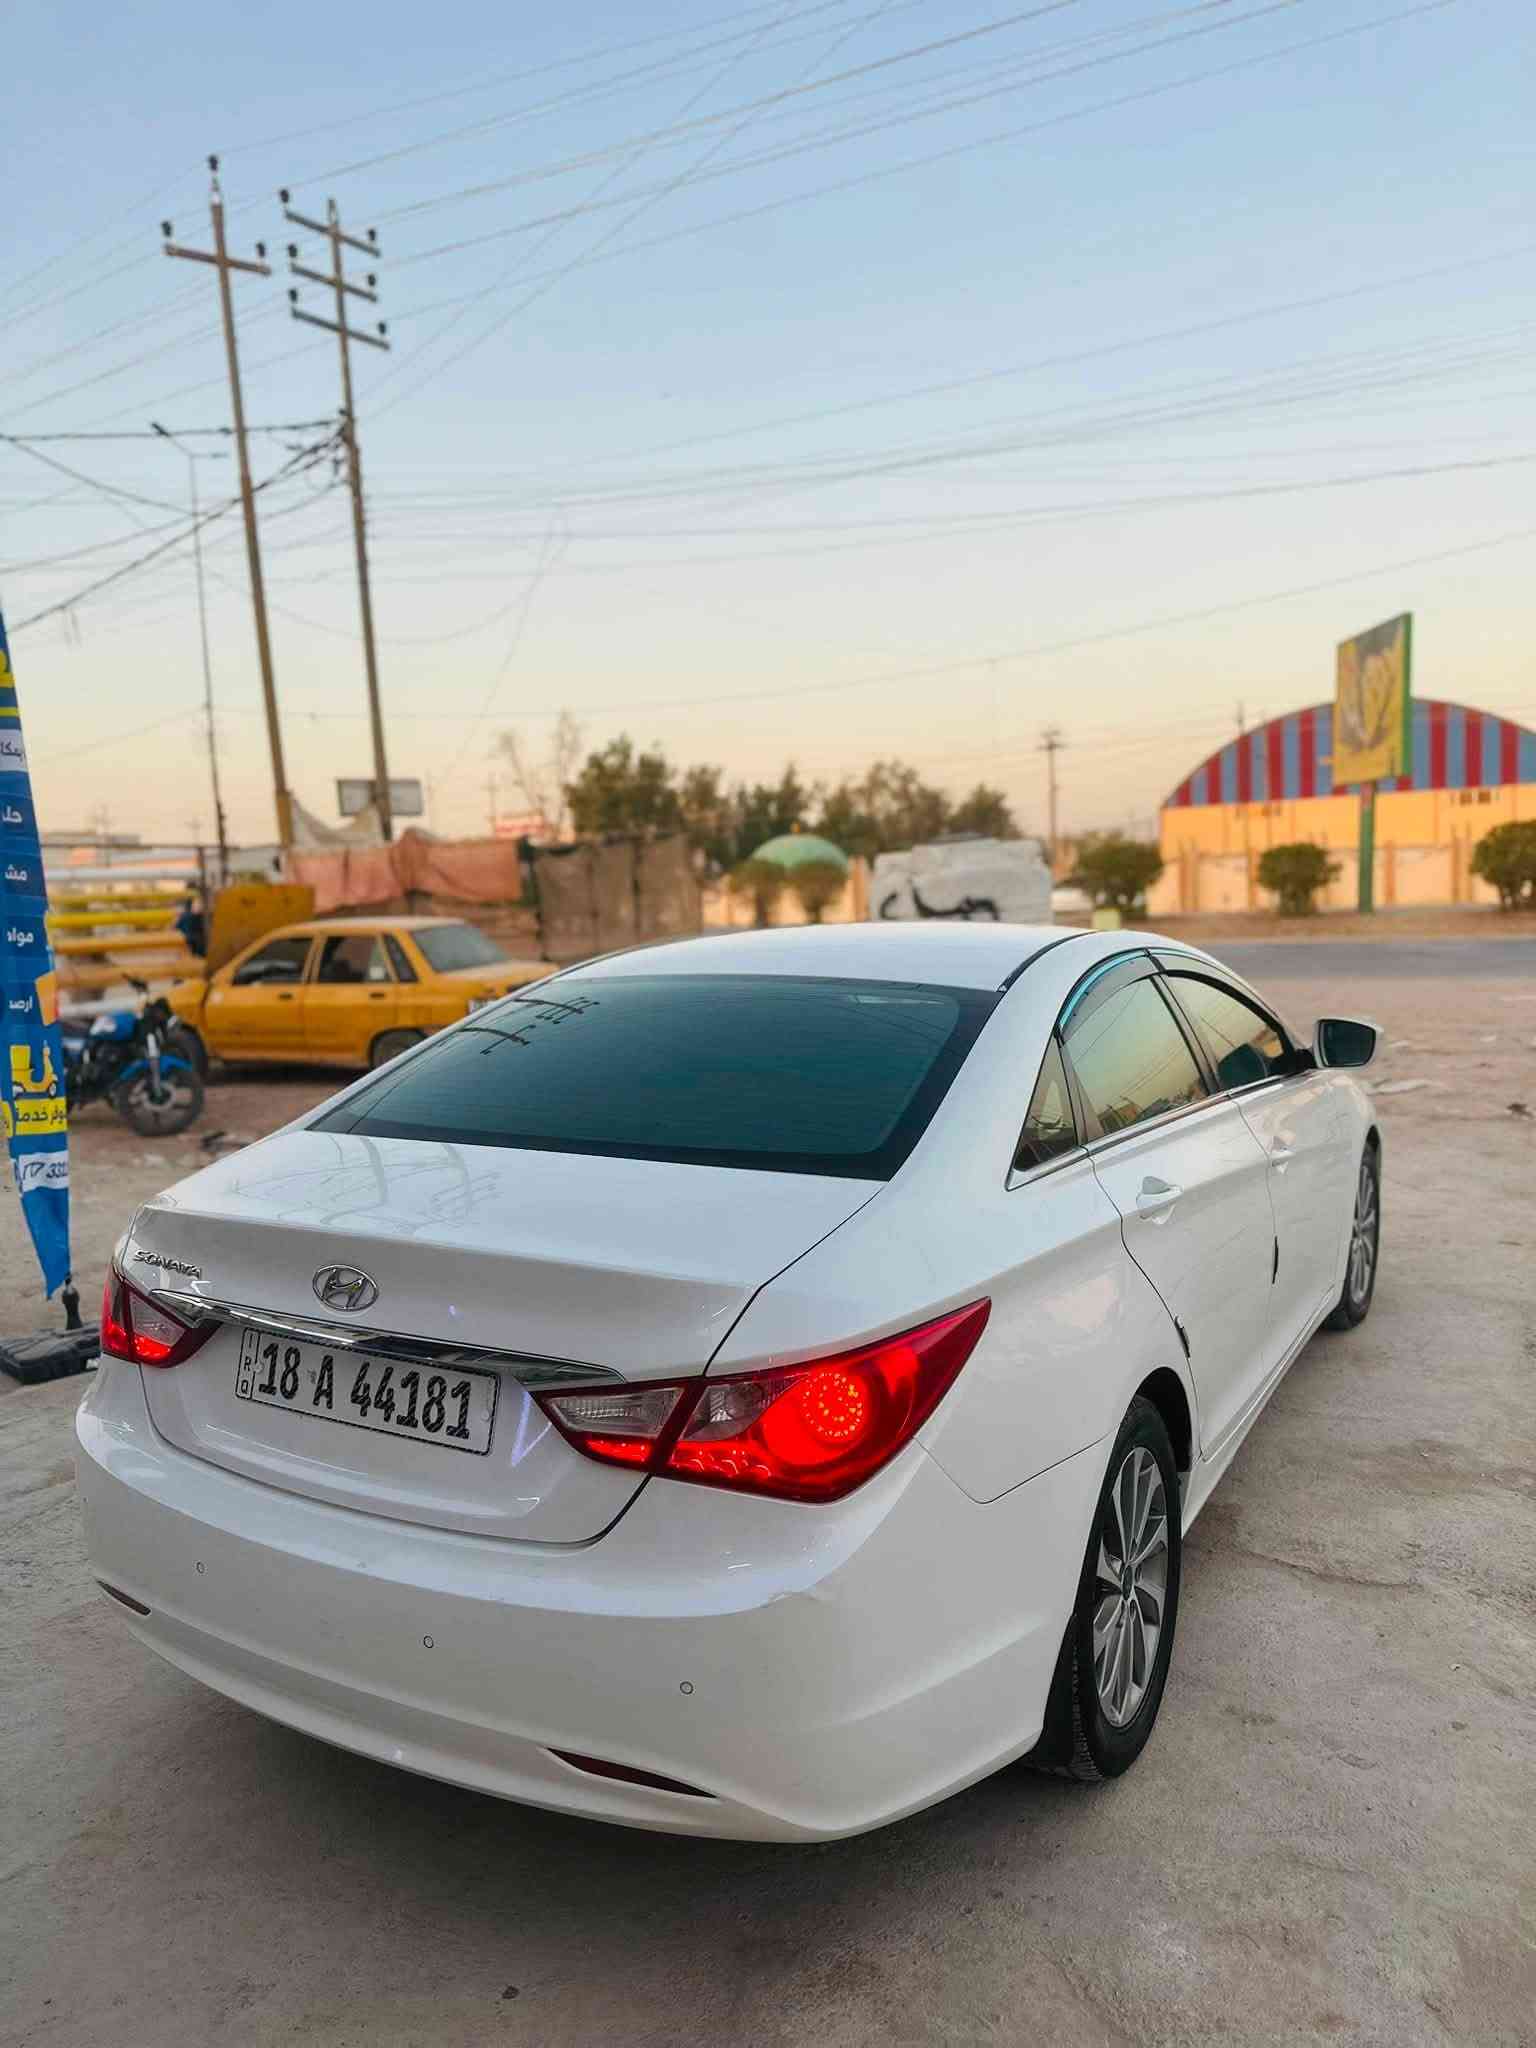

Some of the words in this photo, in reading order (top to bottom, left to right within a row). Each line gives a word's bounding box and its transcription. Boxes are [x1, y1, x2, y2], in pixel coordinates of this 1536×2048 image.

[134, 1249, 202, 1280] SONATA
[258, 1342, 302, 1400] 18
[312, 1354, 334, 1410] A
[350, 1360, 472, 1440] 44181
